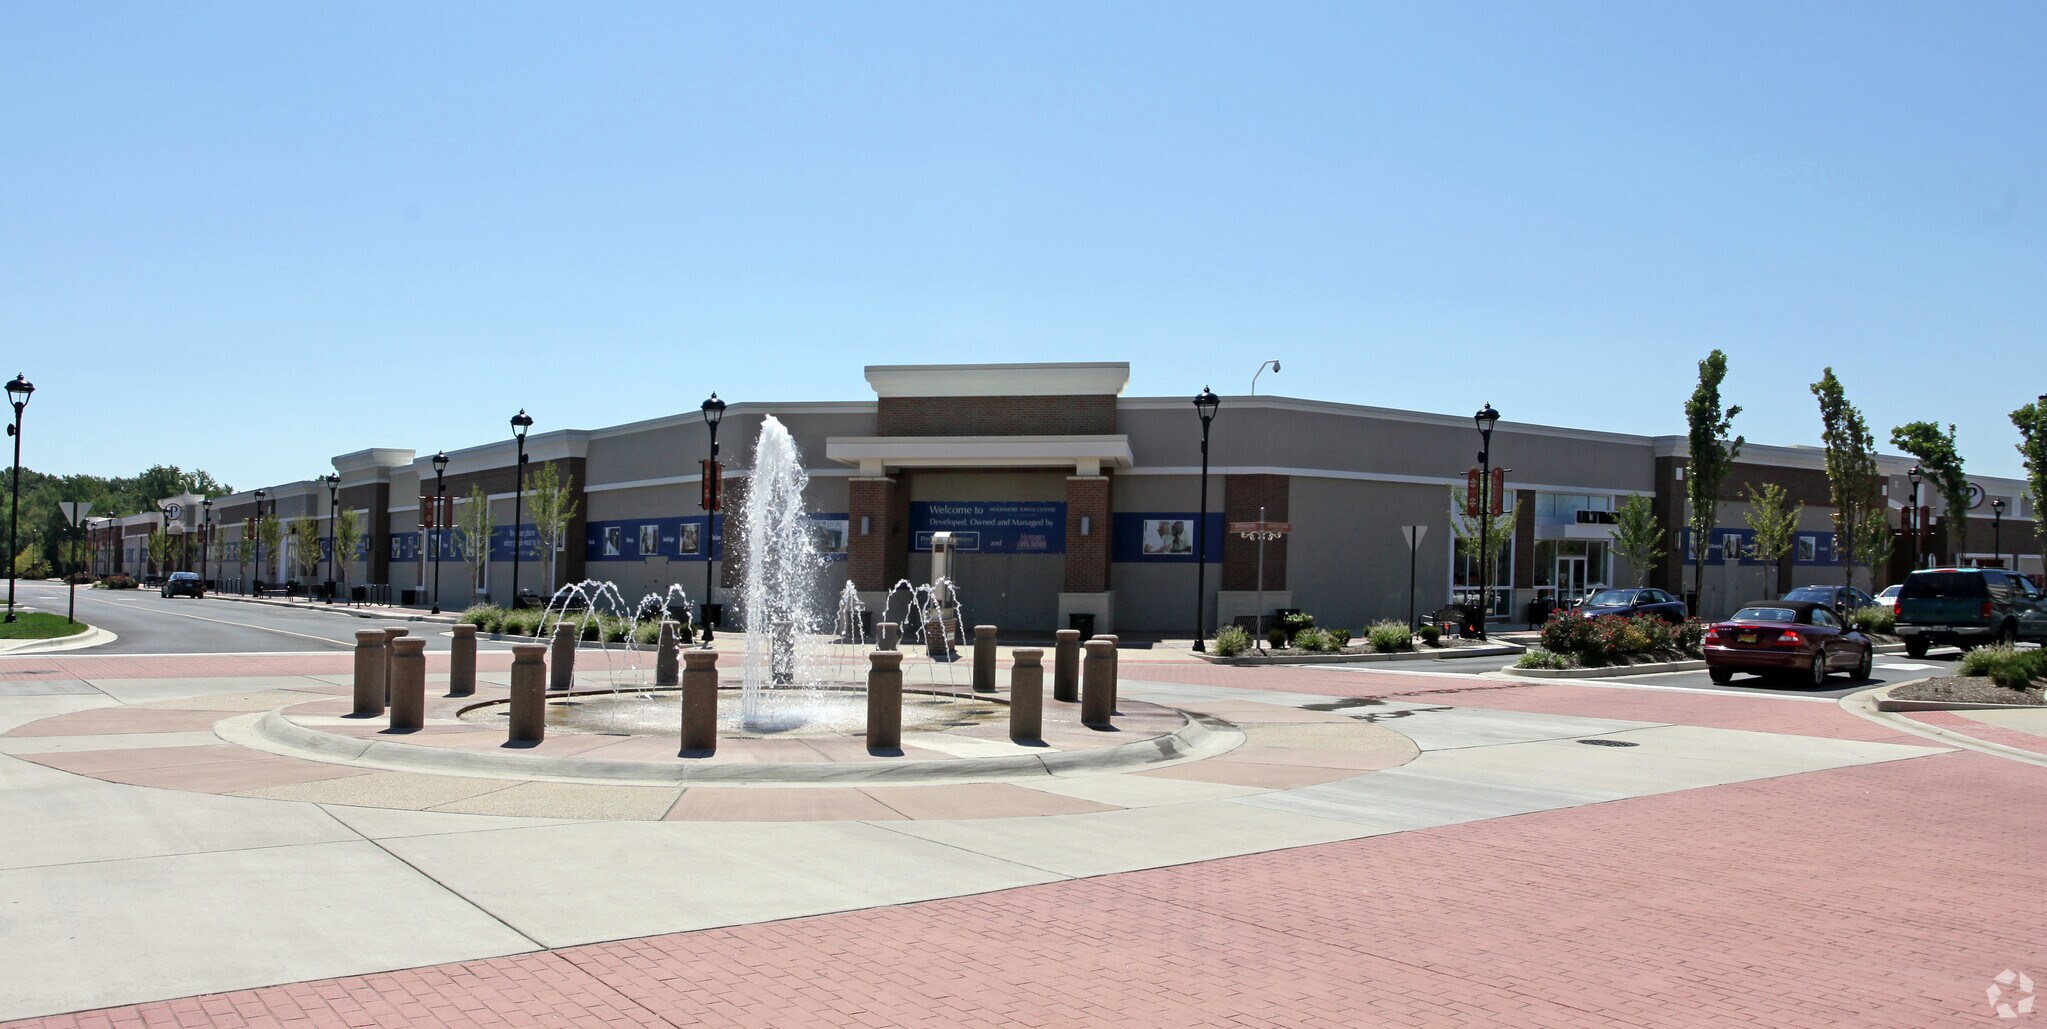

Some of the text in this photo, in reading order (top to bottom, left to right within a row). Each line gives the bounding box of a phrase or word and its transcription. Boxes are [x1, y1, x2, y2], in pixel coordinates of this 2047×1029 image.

[930, 505, 984, 514] Welcome to
[930, 518, 1054, 528] Developed, Owned and Managed by
